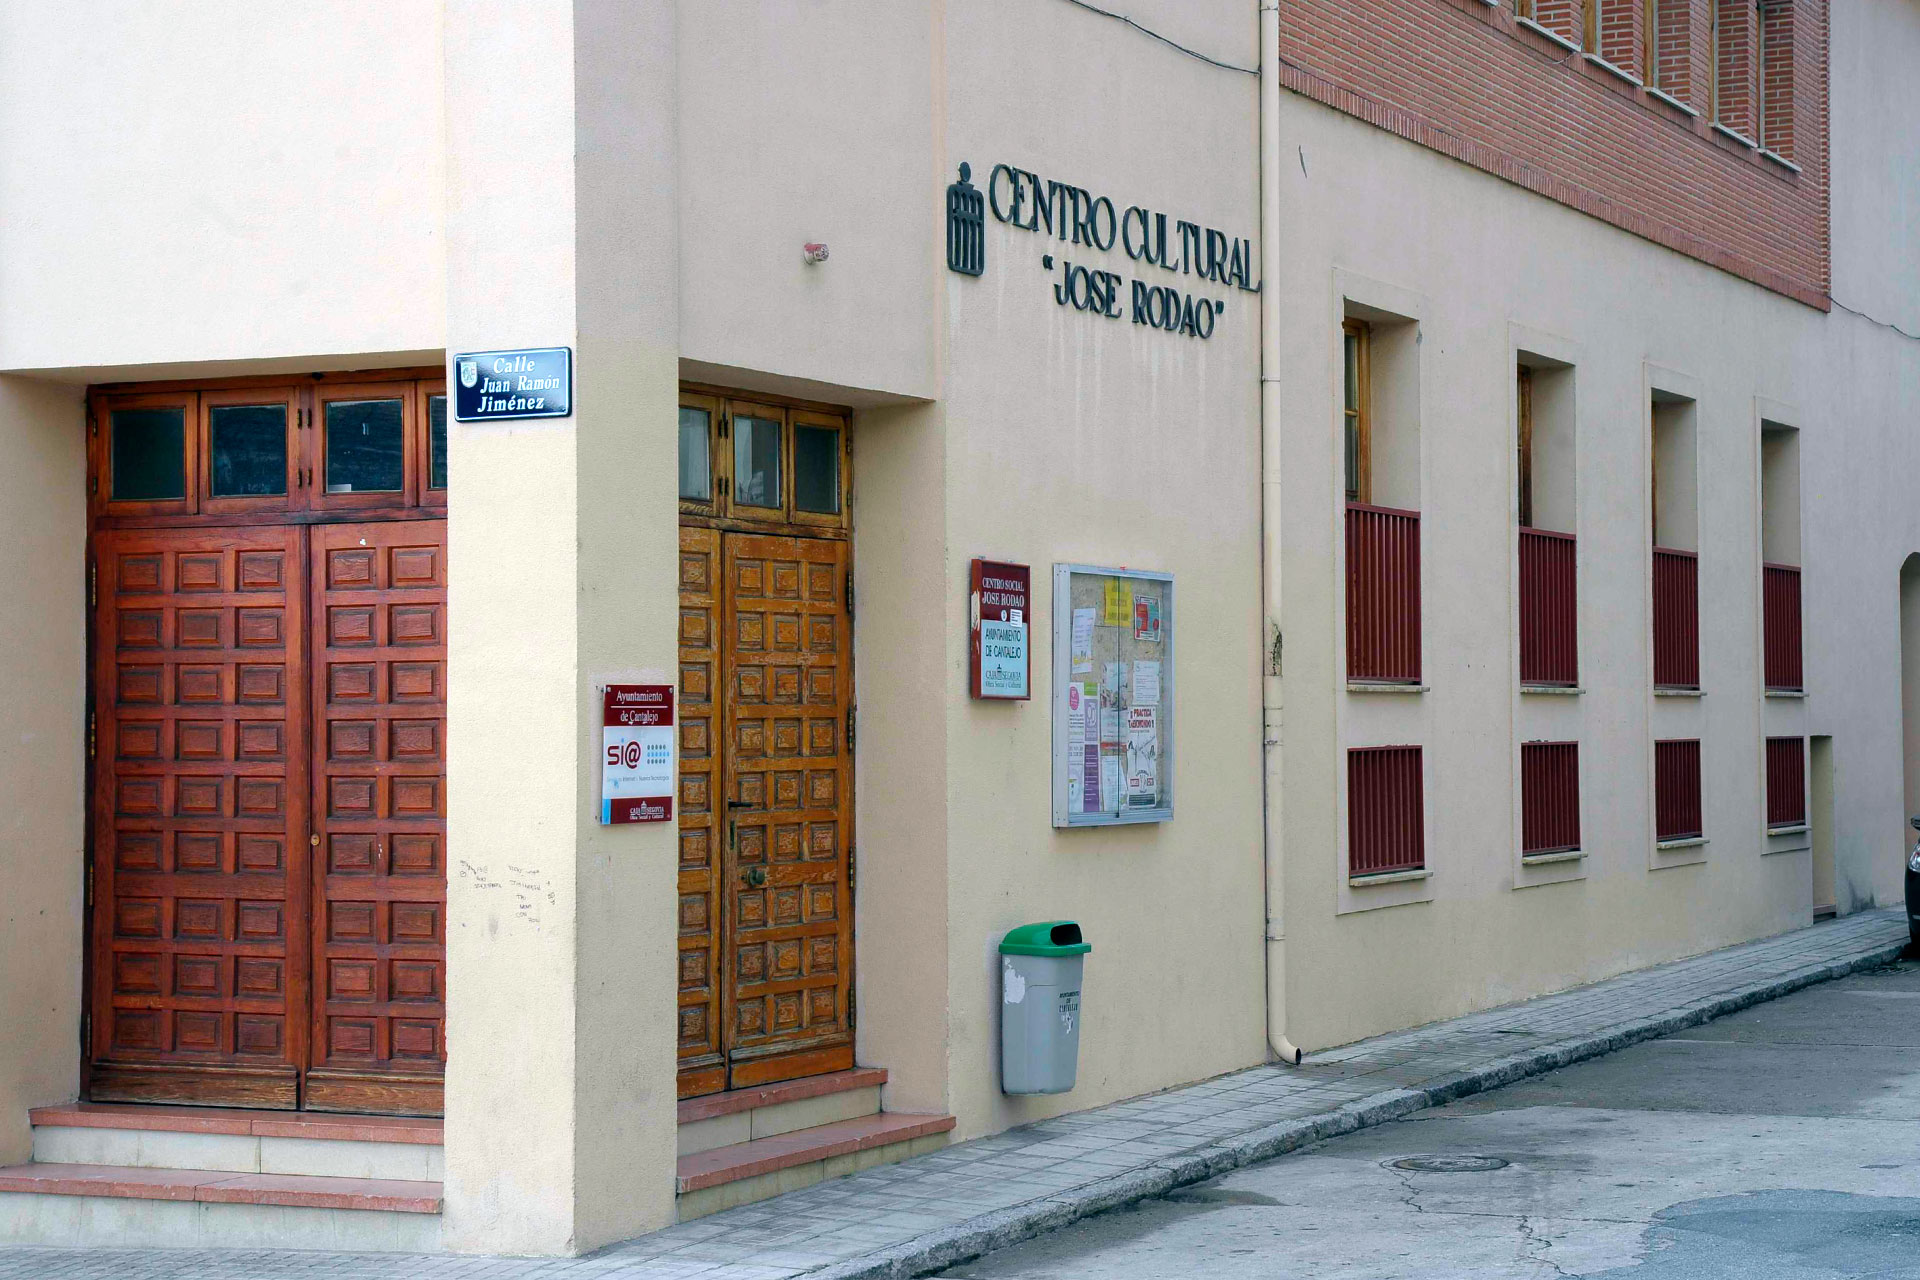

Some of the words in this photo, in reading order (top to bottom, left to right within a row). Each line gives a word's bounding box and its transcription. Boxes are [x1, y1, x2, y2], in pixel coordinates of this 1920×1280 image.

[989, 163, 1117, 251] CENTRO
[1122, 205, 1262, 293] CULTURAL
[1043, 254, 1123, 319] "JOSE
[1132, 279, 1224, 339] RODAO"
[493, 355, 536, 374] Calle
[480, 377, 510, 394] Juan
[517, 375, 560, 391] Ramón
[477, 394, 545, 413] Jiménez
[982, 577, 1004, 589] CENTRO
[1004, 580, 1025, 592] SOCIAL
[982, 593, 1000, 606] JOSE
[1001, 594, 1025, 608] RODAO
[985, 629, 1021, 642] AYUNTAMIENTO
[985, 645, 992, 657] DE
[993, 646, 1021, 659] CANTALEJO
[616, 690, 663, 704] Ayuntamiento
[620, 711, 629, 722] de
[629, 710, 659, 725] Cantalejo
